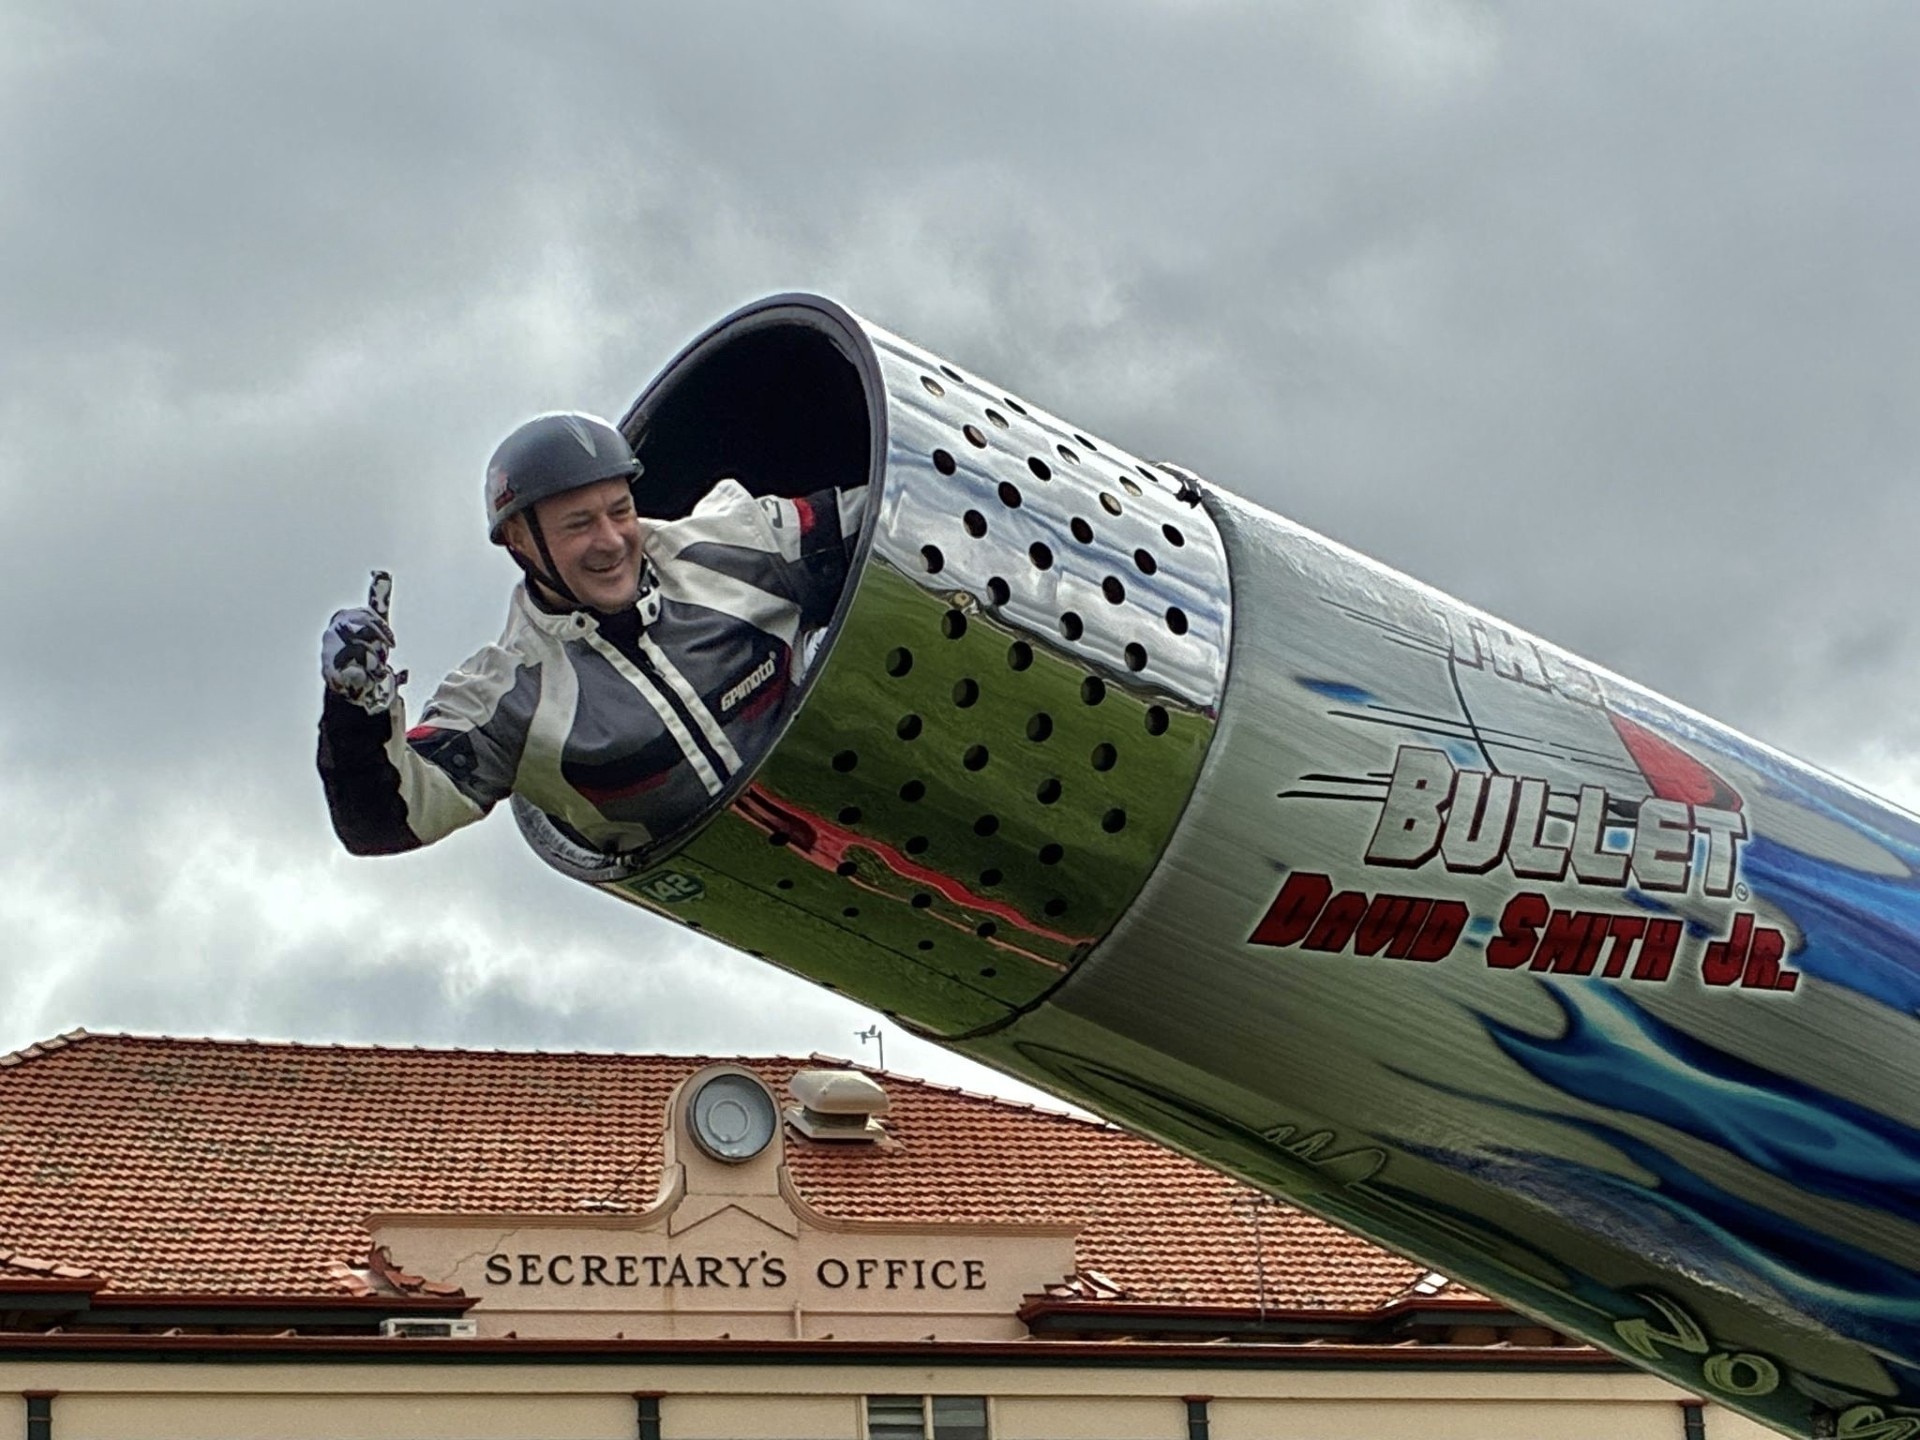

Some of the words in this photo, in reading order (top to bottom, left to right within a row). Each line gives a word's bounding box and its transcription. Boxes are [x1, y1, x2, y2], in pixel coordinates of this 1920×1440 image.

[1364, 745, 1748, 898] BULLET
[1247, 871, 1470, 963] DAVID
[1486, 893, 1683, 982] SMITH
[485, 1250, 787, 1288] SECRETARY'S
[817, 1259, 987, 1291] OFFICE
